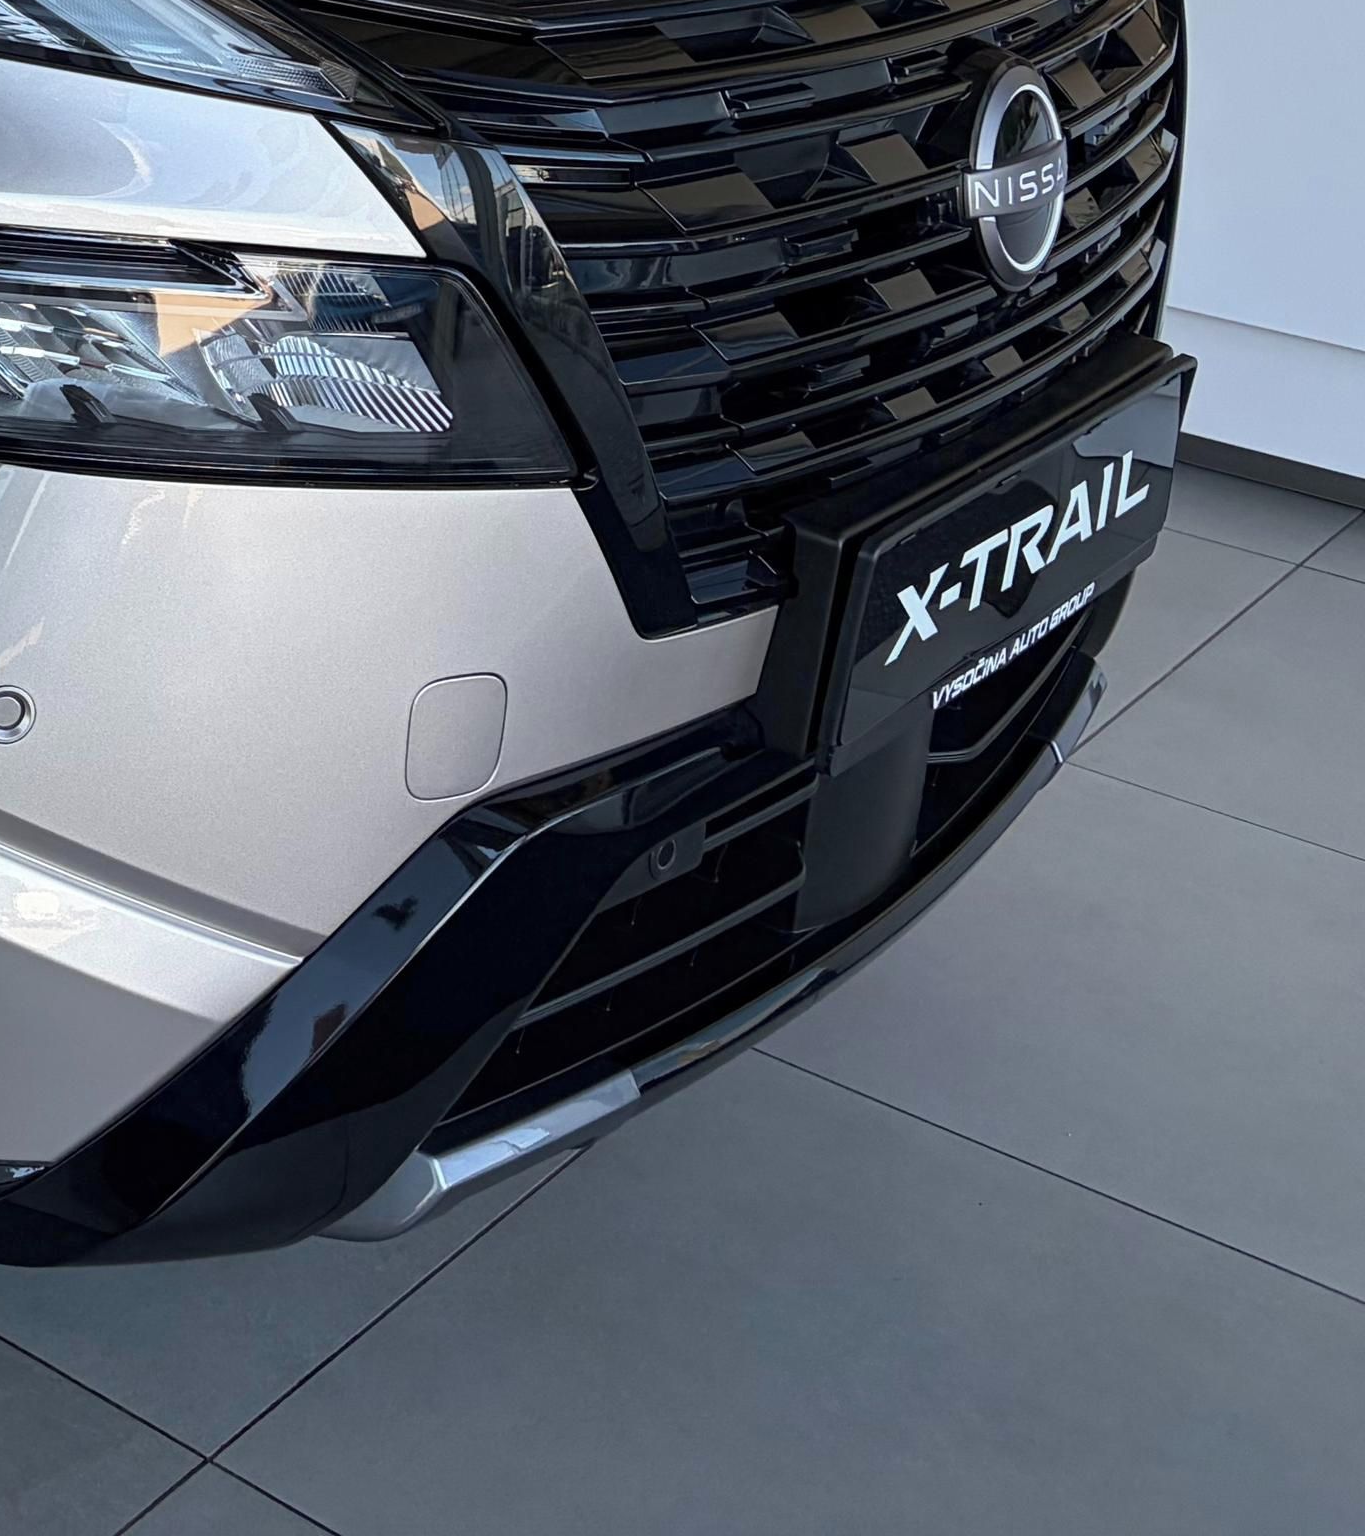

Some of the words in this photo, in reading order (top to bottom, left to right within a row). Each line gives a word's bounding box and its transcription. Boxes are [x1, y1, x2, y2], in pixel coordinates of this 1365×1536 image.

[974, 157, 1065, 210] NISSA
[884, 449, 1150, 666] X-TRAIL
[932, 647, 1007, 710] VYSOČINA
[1008, 615, 1049, 660] AUTO
[1049, 581, 1096, 630] GROUP
